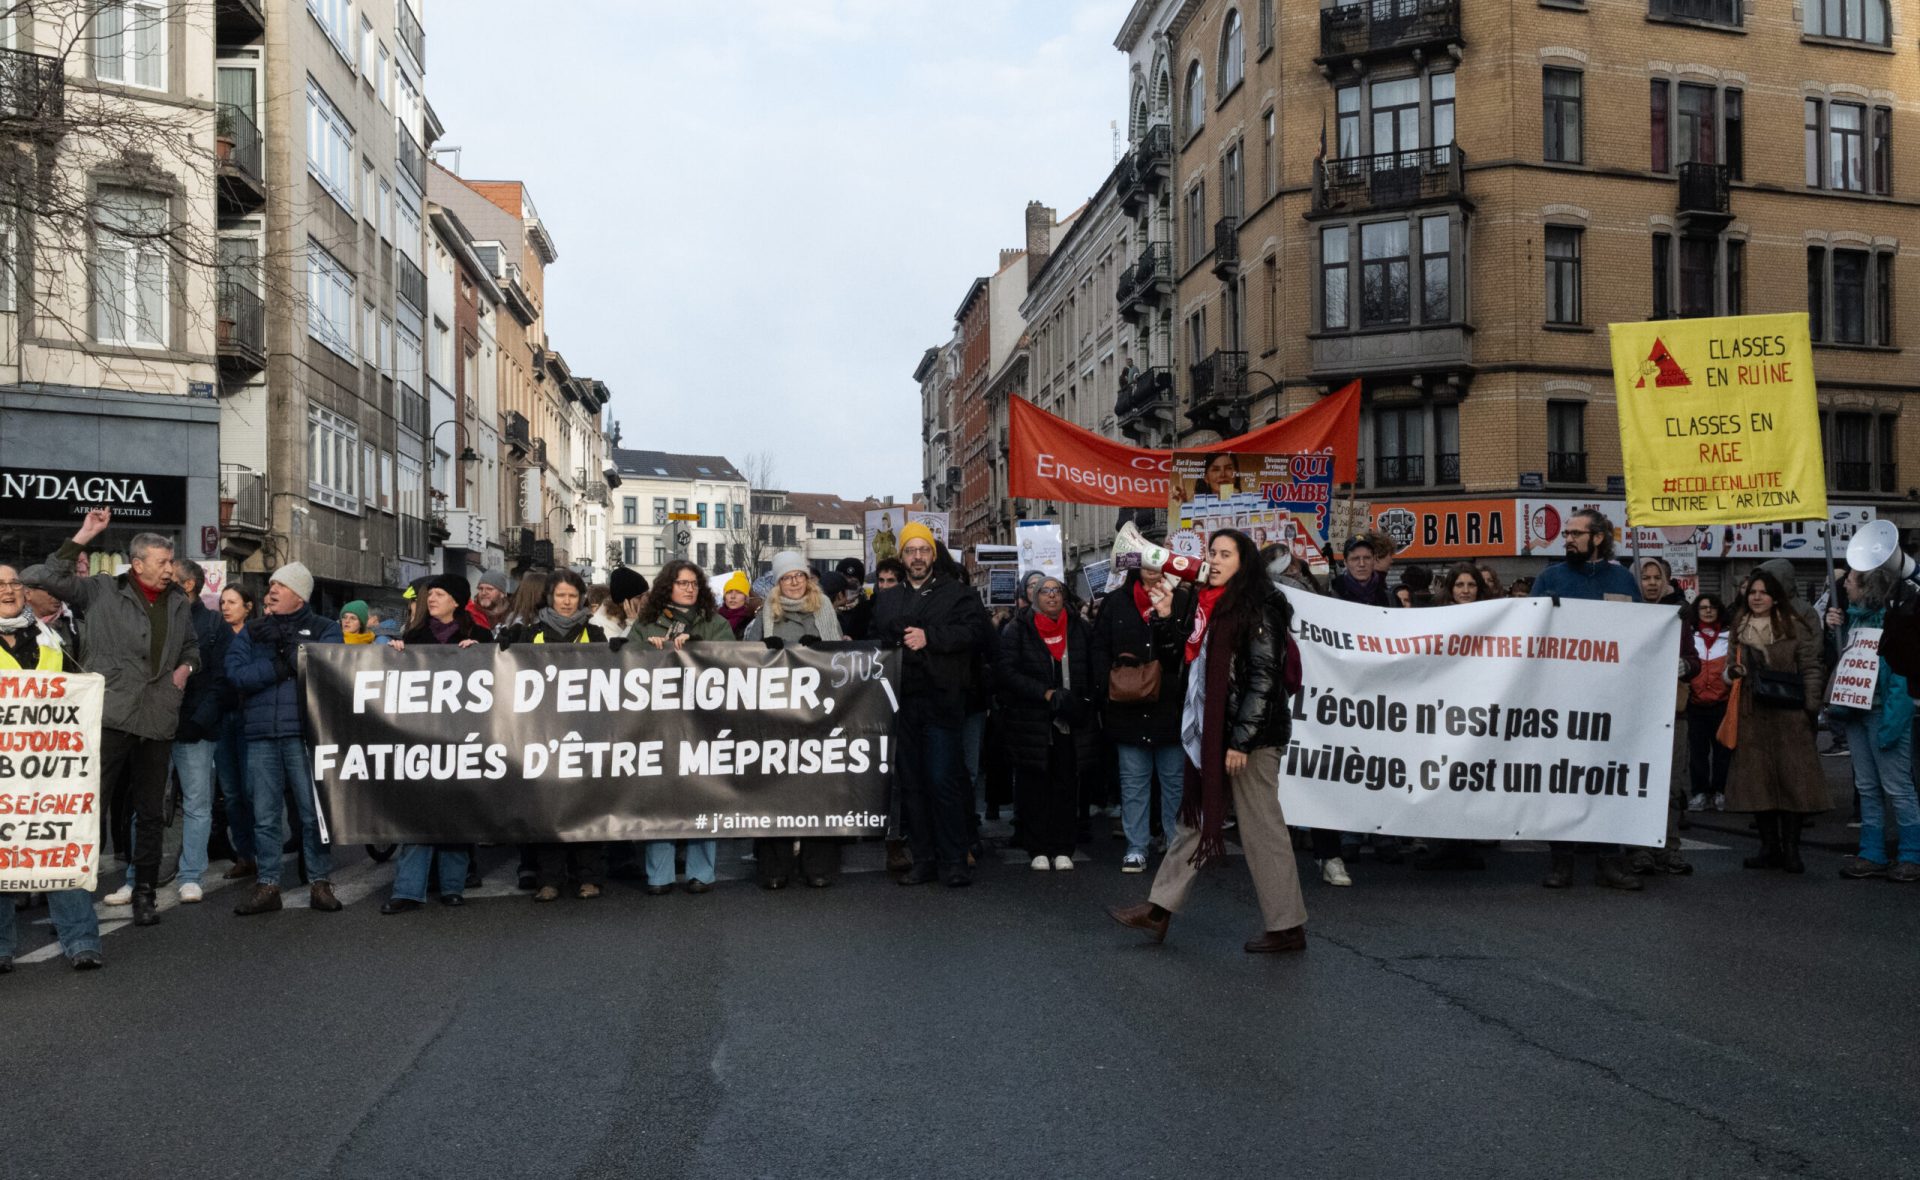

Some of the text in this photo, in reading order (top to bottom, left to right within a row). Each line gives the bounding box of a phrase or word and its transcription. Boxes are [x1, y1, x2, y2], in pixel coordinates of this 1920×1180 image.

[1709, 336, 1786, 360] CLASSES
[1707, 367, 1729, 387] EN
[1666, 412, 1773, 437] CLASSES EN
[1699, 442, 1743, 464] RAGE
[1290, 455, 1329, 481] QUI
[2, 473, 152, 504] N'DAGNA
[1259, 481, 1329, 503] TOMBE
[1663, 472, 1783, 493] #ECOLEENLUTTE
[113, 507, 152, 517] TEXTILES
[1652, 496, 1708, 512] CONTRE
[1316, 504, 1327, 530] ?
[1423, 511, 1504, 546] BARA
[1625, 531, 1658, 540] MDIA
[1736, 544, 1759, 552] SALE
[1300, 619, 1619, 663] ECOLE EN LUTTE CONTRE L'ARIZONA
[1843, 658, 1877, 671] FORCE
[353, 664, 836, 715] FIERS D'ENSEIGNER,
[1835, 675, 1872, 688] AMOUR
[1292, 685, 1612, 742] L'école n'est pas un
[0, 731, 84, 753] UJOURS
[314, 732, 508, 781] FATIGUÉS
[522, 730, 663, 780] D'ÊTRE
[678, 727, 871, 777] MÉPRISÉS
[0, 755, 89, 779] BOUT!
[1420, 754, 1497, 792] c'est
[1503, 762, 1542, 793] un
[1549, 758, 1630, 796] droit
[776, 814, 819, 828] mon
[825, 810, 887, 828] métier
[1, 820, 72, 841] C'EST
